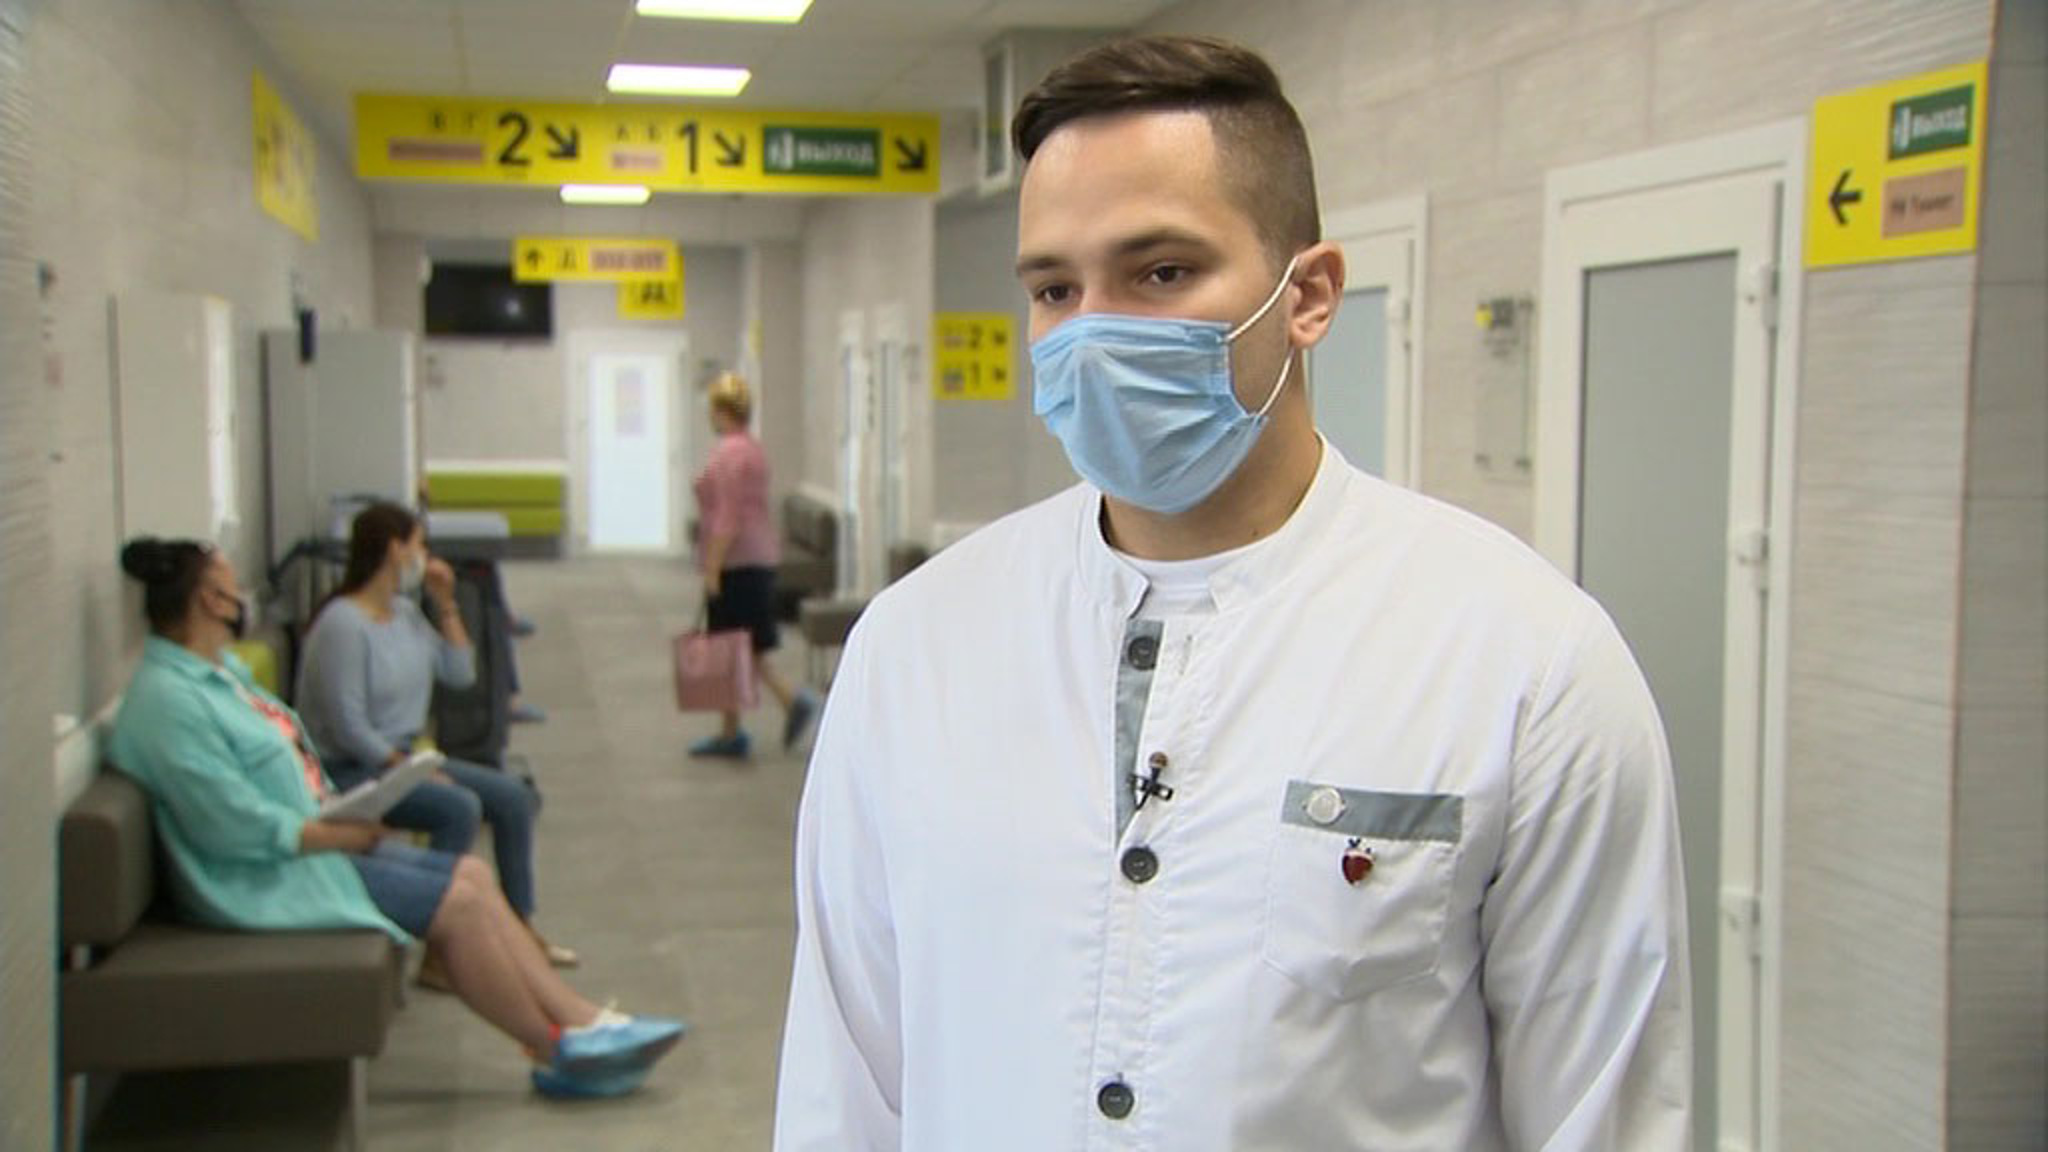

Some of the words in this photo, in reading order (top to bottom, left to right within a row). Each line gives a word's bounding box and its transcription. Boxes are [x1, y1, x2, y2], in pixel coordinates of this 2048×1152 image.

[497, 111, 532, 166] 2
[677, 120, 699, 175] 1
[798, 140, 875, 168] ВЫХОД
